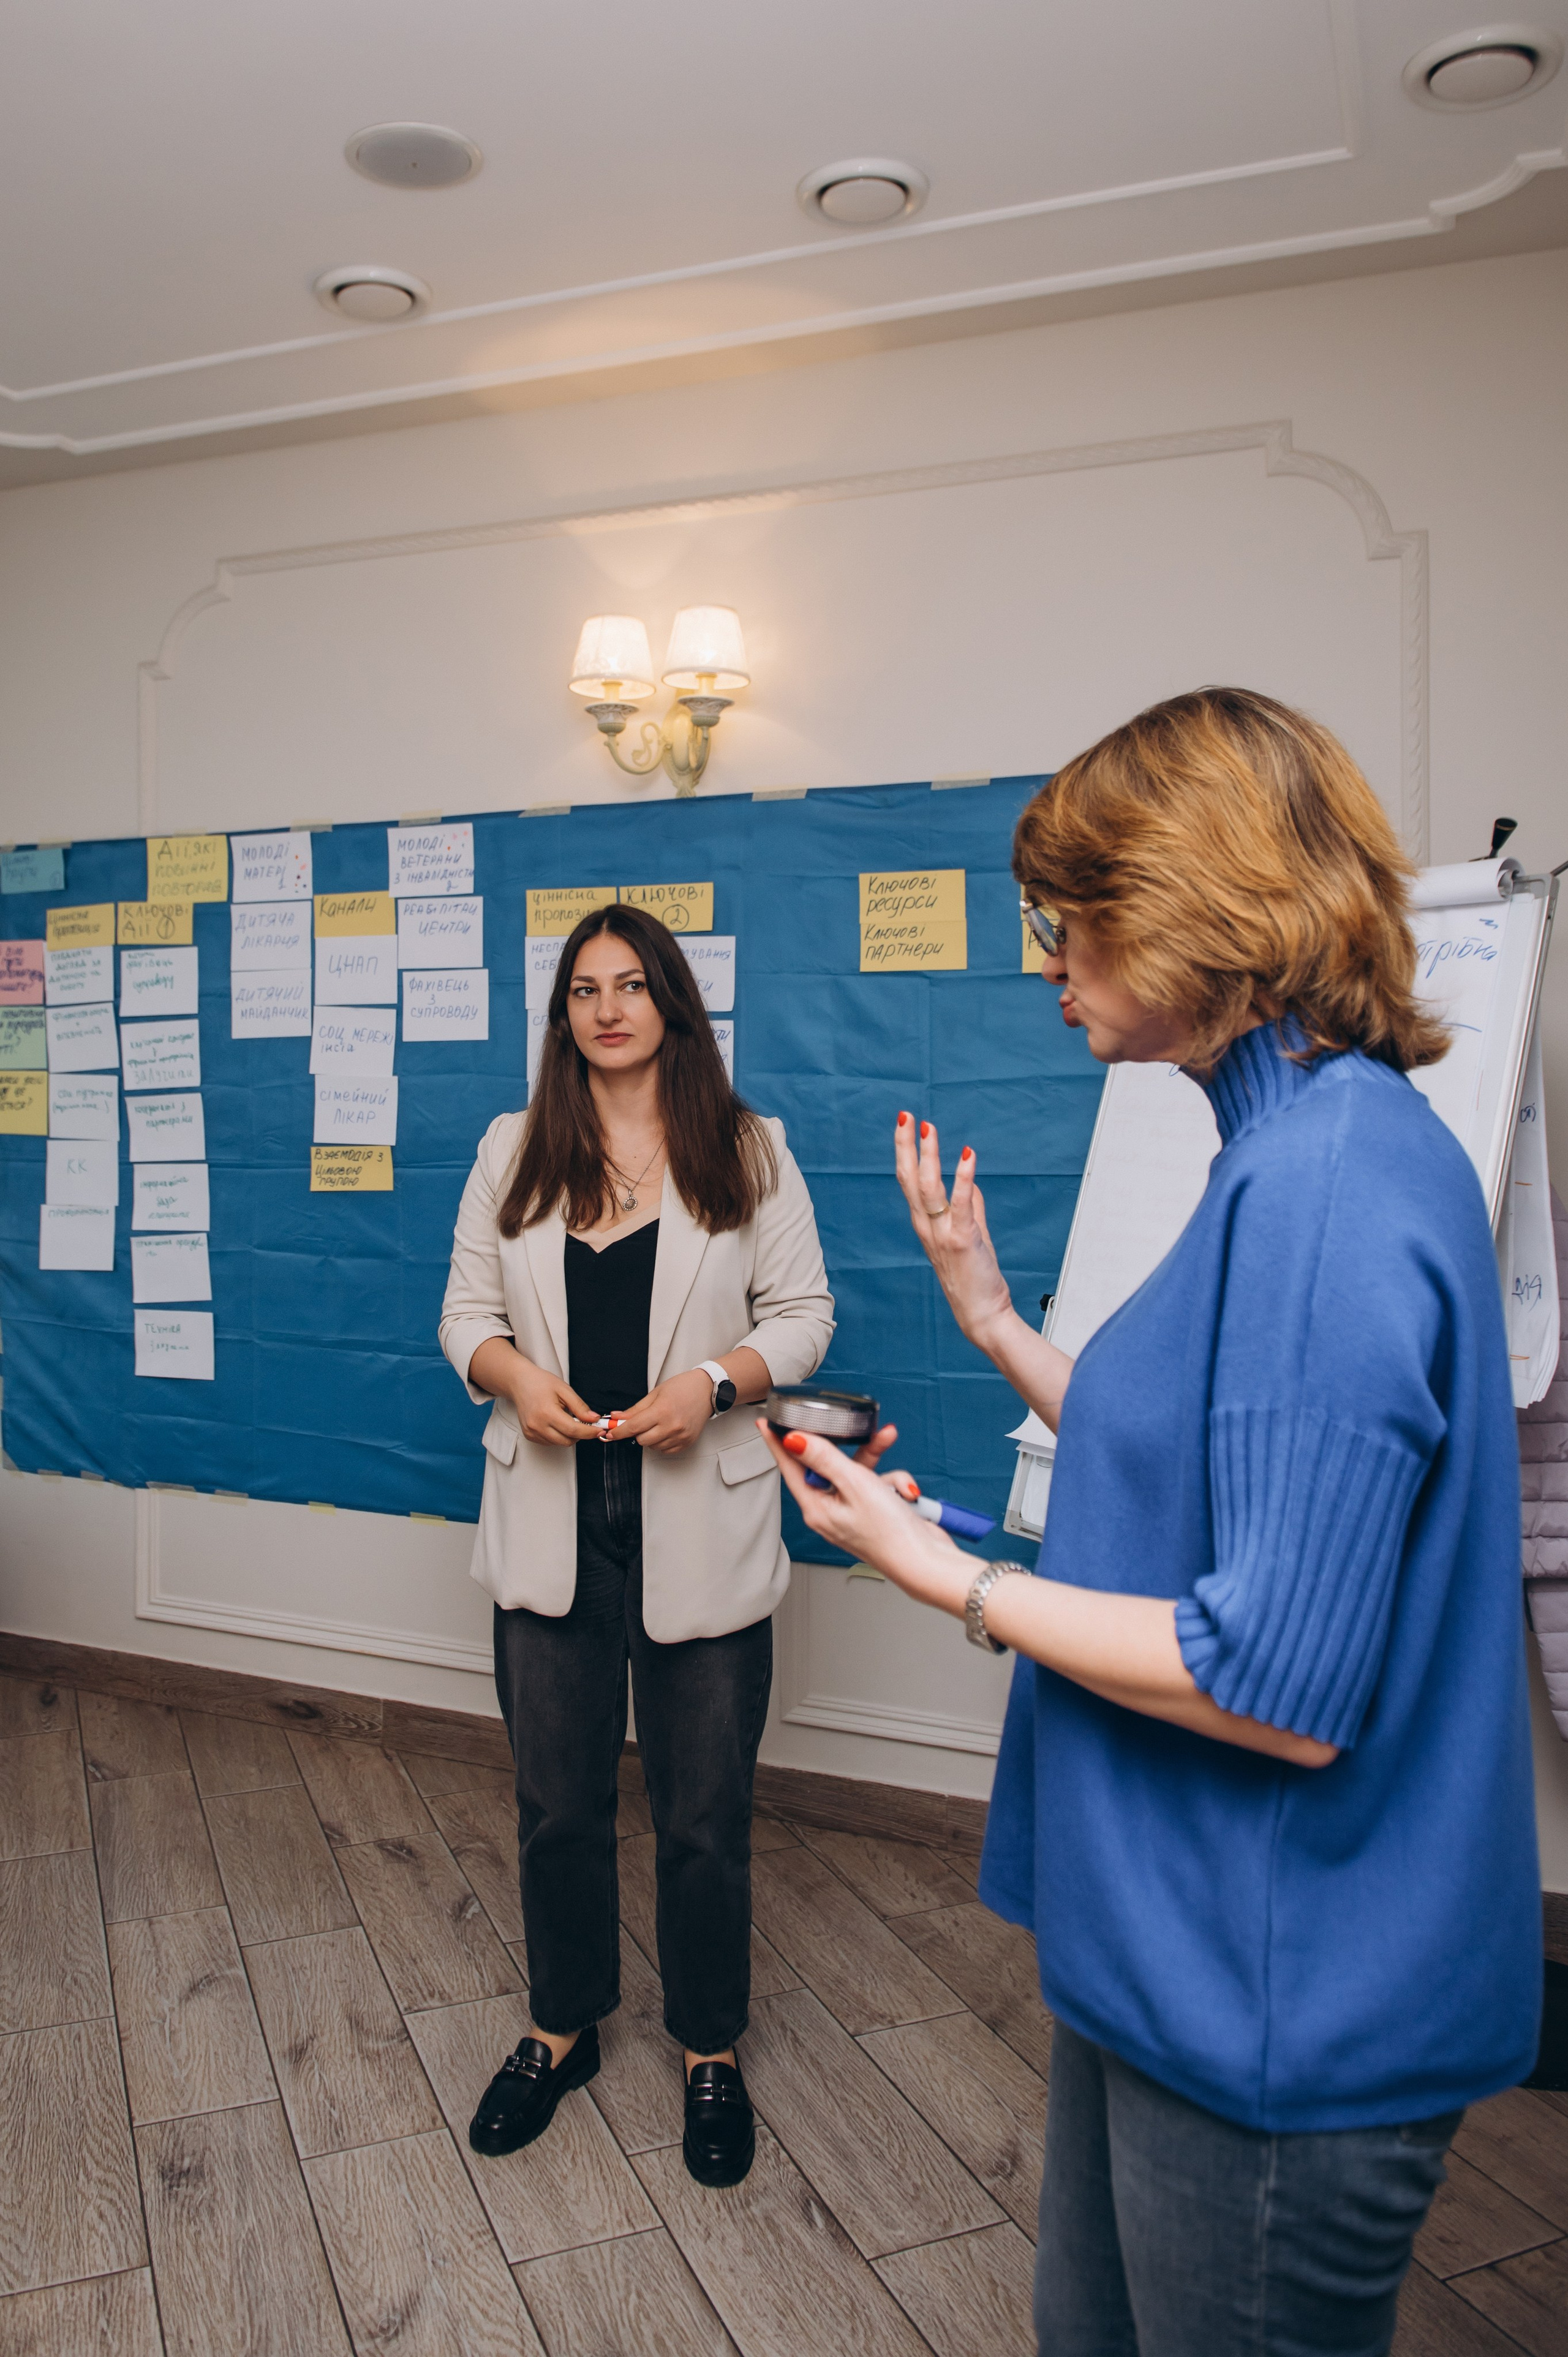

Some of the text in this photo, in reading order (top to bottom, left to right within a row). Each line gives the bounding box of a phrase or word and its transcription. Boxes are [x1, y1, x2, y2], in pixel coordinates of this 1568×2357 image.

[241, 842, 290, 861] МОЛОДІ
[398, 834, 446, 853] МОЛОДІ
[401, 854, 462, 870] ВЕТЕРАНИ
[235, 912, 295, 934] ДИТЯЧА
[418, 921, 472, 937] ЦЕНТРИ
[241, 935, 300, 950] ЛІКАРНЯ
[328, 954, 379, 978] ЦНАП
[409, 976, 470, 994] ФАХІВЕЦЬ
[240, 1005, 309, 1022] МАЙДАНЧИК
[410, 1005, 478, 1020] СУПРОВОДУ
[333, 1107, 377, 1125] ЛІКАР
